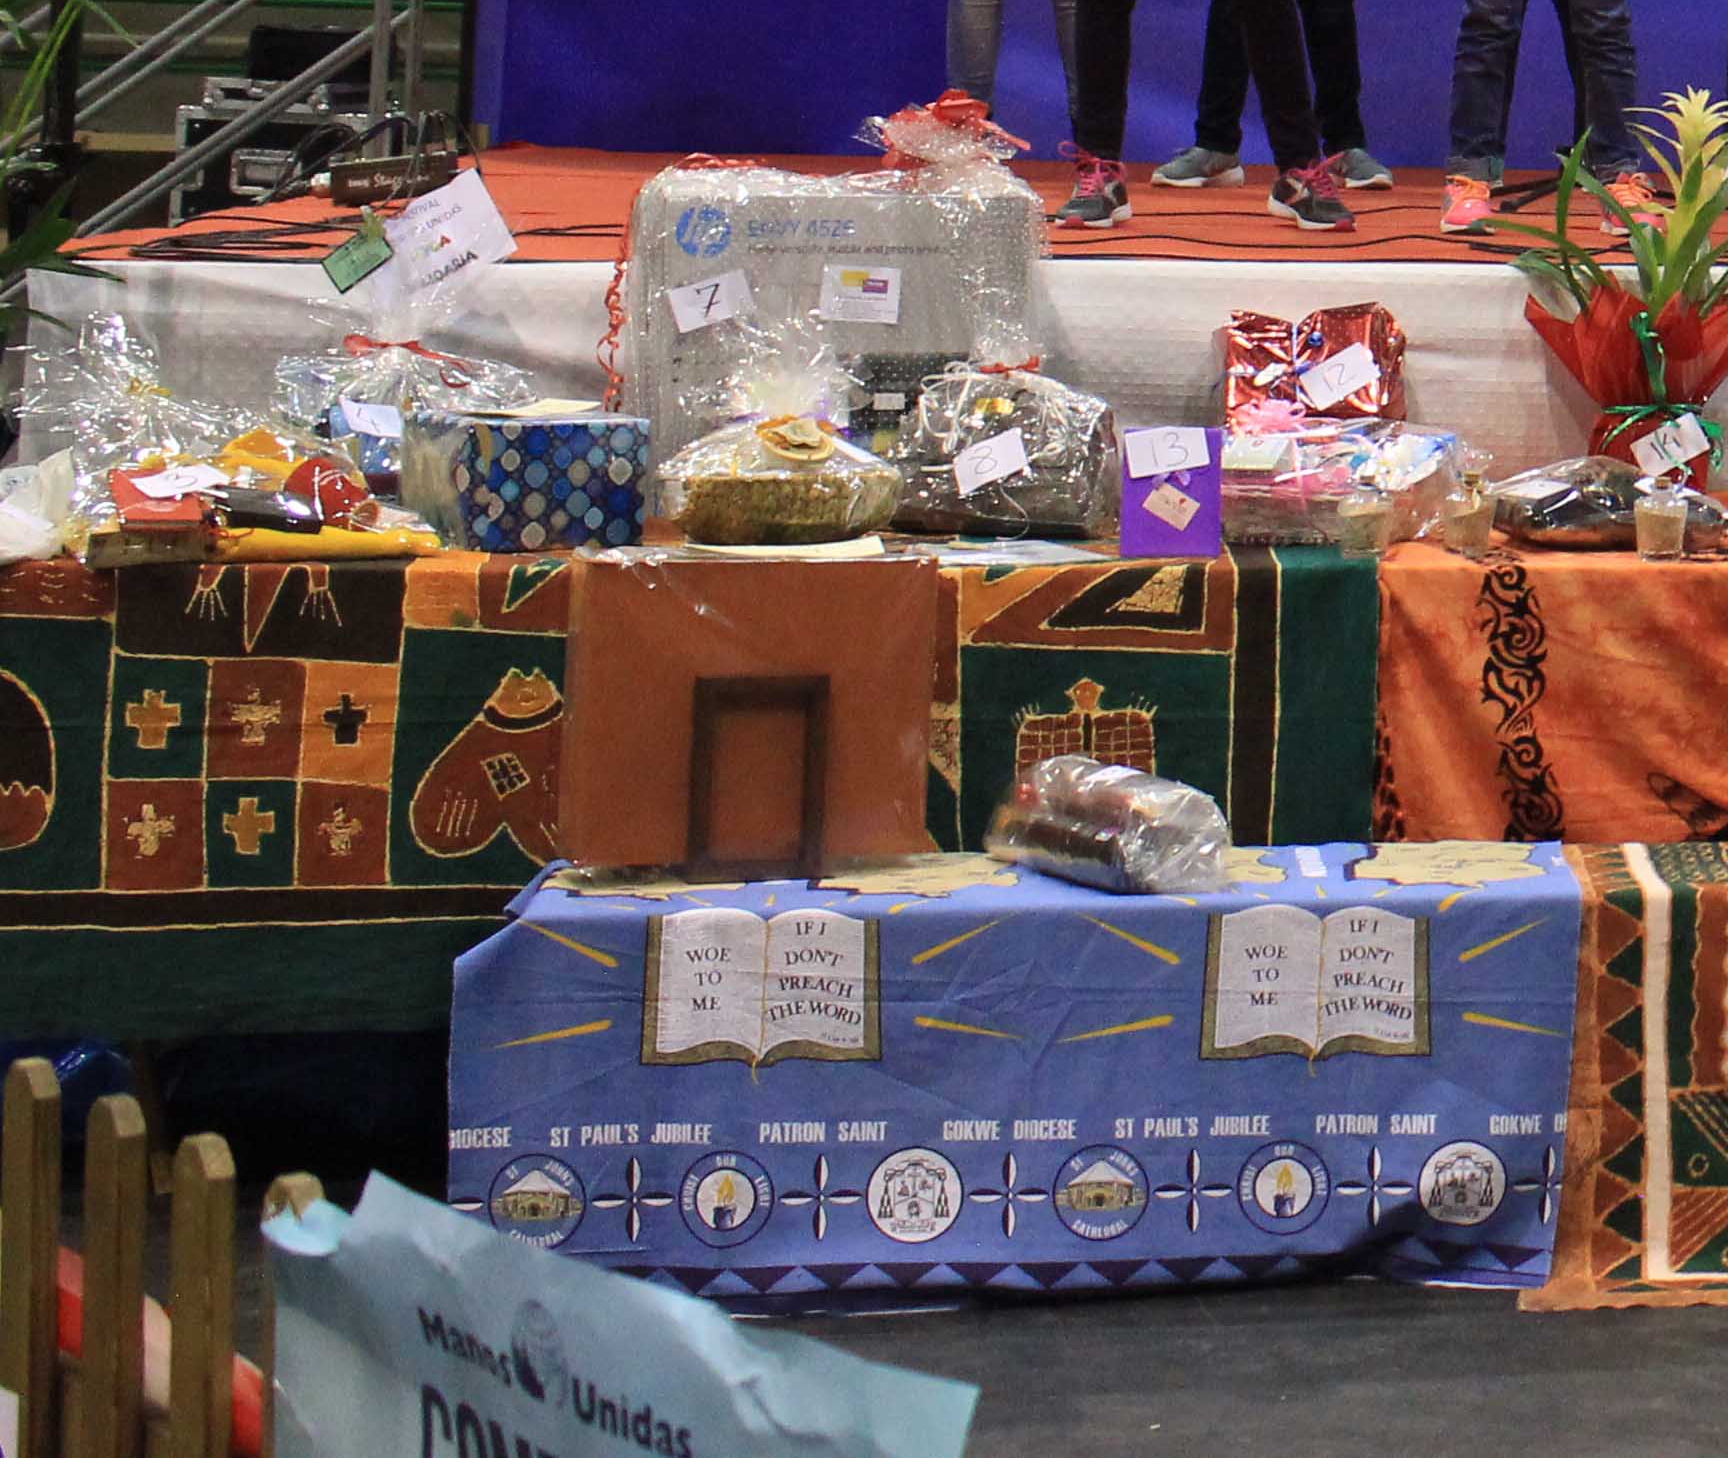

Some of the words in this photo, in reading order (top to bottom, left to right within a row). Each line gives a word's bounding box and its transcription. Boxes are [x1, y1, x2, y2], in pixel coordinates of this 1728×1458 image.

[695, 283, 721, 319] 7
[1150, 431, 1189, 468] 13
[795, 921, 813, 936] IF
[1350, 918, 1368, 934] IF
[686, 946, 732, 964] WOE
[784, 949, 845, 967] DON'T
[1244, 944, 1289, 961] WOE
[1338, 945, 1395, 964] DON'T
[694, 970, 722, 987] TO
[1252, 967, 1280, 983] TO
[1333, 970, 1407, 995] PREACH
[778, 975, 855, 999] PREACH
[691, 996, 721, 1012] ME
[1250, 991, 1279, 1007] ME
[1324, 996, 1361, 1017] THE
[1363, 996, 1413, 1021] WORD
[768, 1000, 807, 1023] THE
[809, 1000, 862, 1026] WORD
[550, 1125, 571, 1148] ST
[580, 1123, 640, 1147] PAUL'S
[651, 1122, 713, 1146] JUBILEE
[759, 1120, 827, 1143] PATRON
[837, 1120, 889, 1142] SAINT
[943, 1119, 1001, 1141] GOKWE
[1013, 1118, 1077, 1141] DIOCESE
[1114, 1117, 1135, 1139] ST
[1143, 1115, 1199, 1139] PAUL'S
[1209, 1114, 1272, 1137] JUBILEE
[1315, 1113, 1379, 1136] PATRON
[1389, 1113, 1438, 1135] SAINT
[1489, 1114, 1543, 1136] GOKWE
[417, 1305, 512, 1389] Manos
[572, 1376, 692, 1458] Unidas
